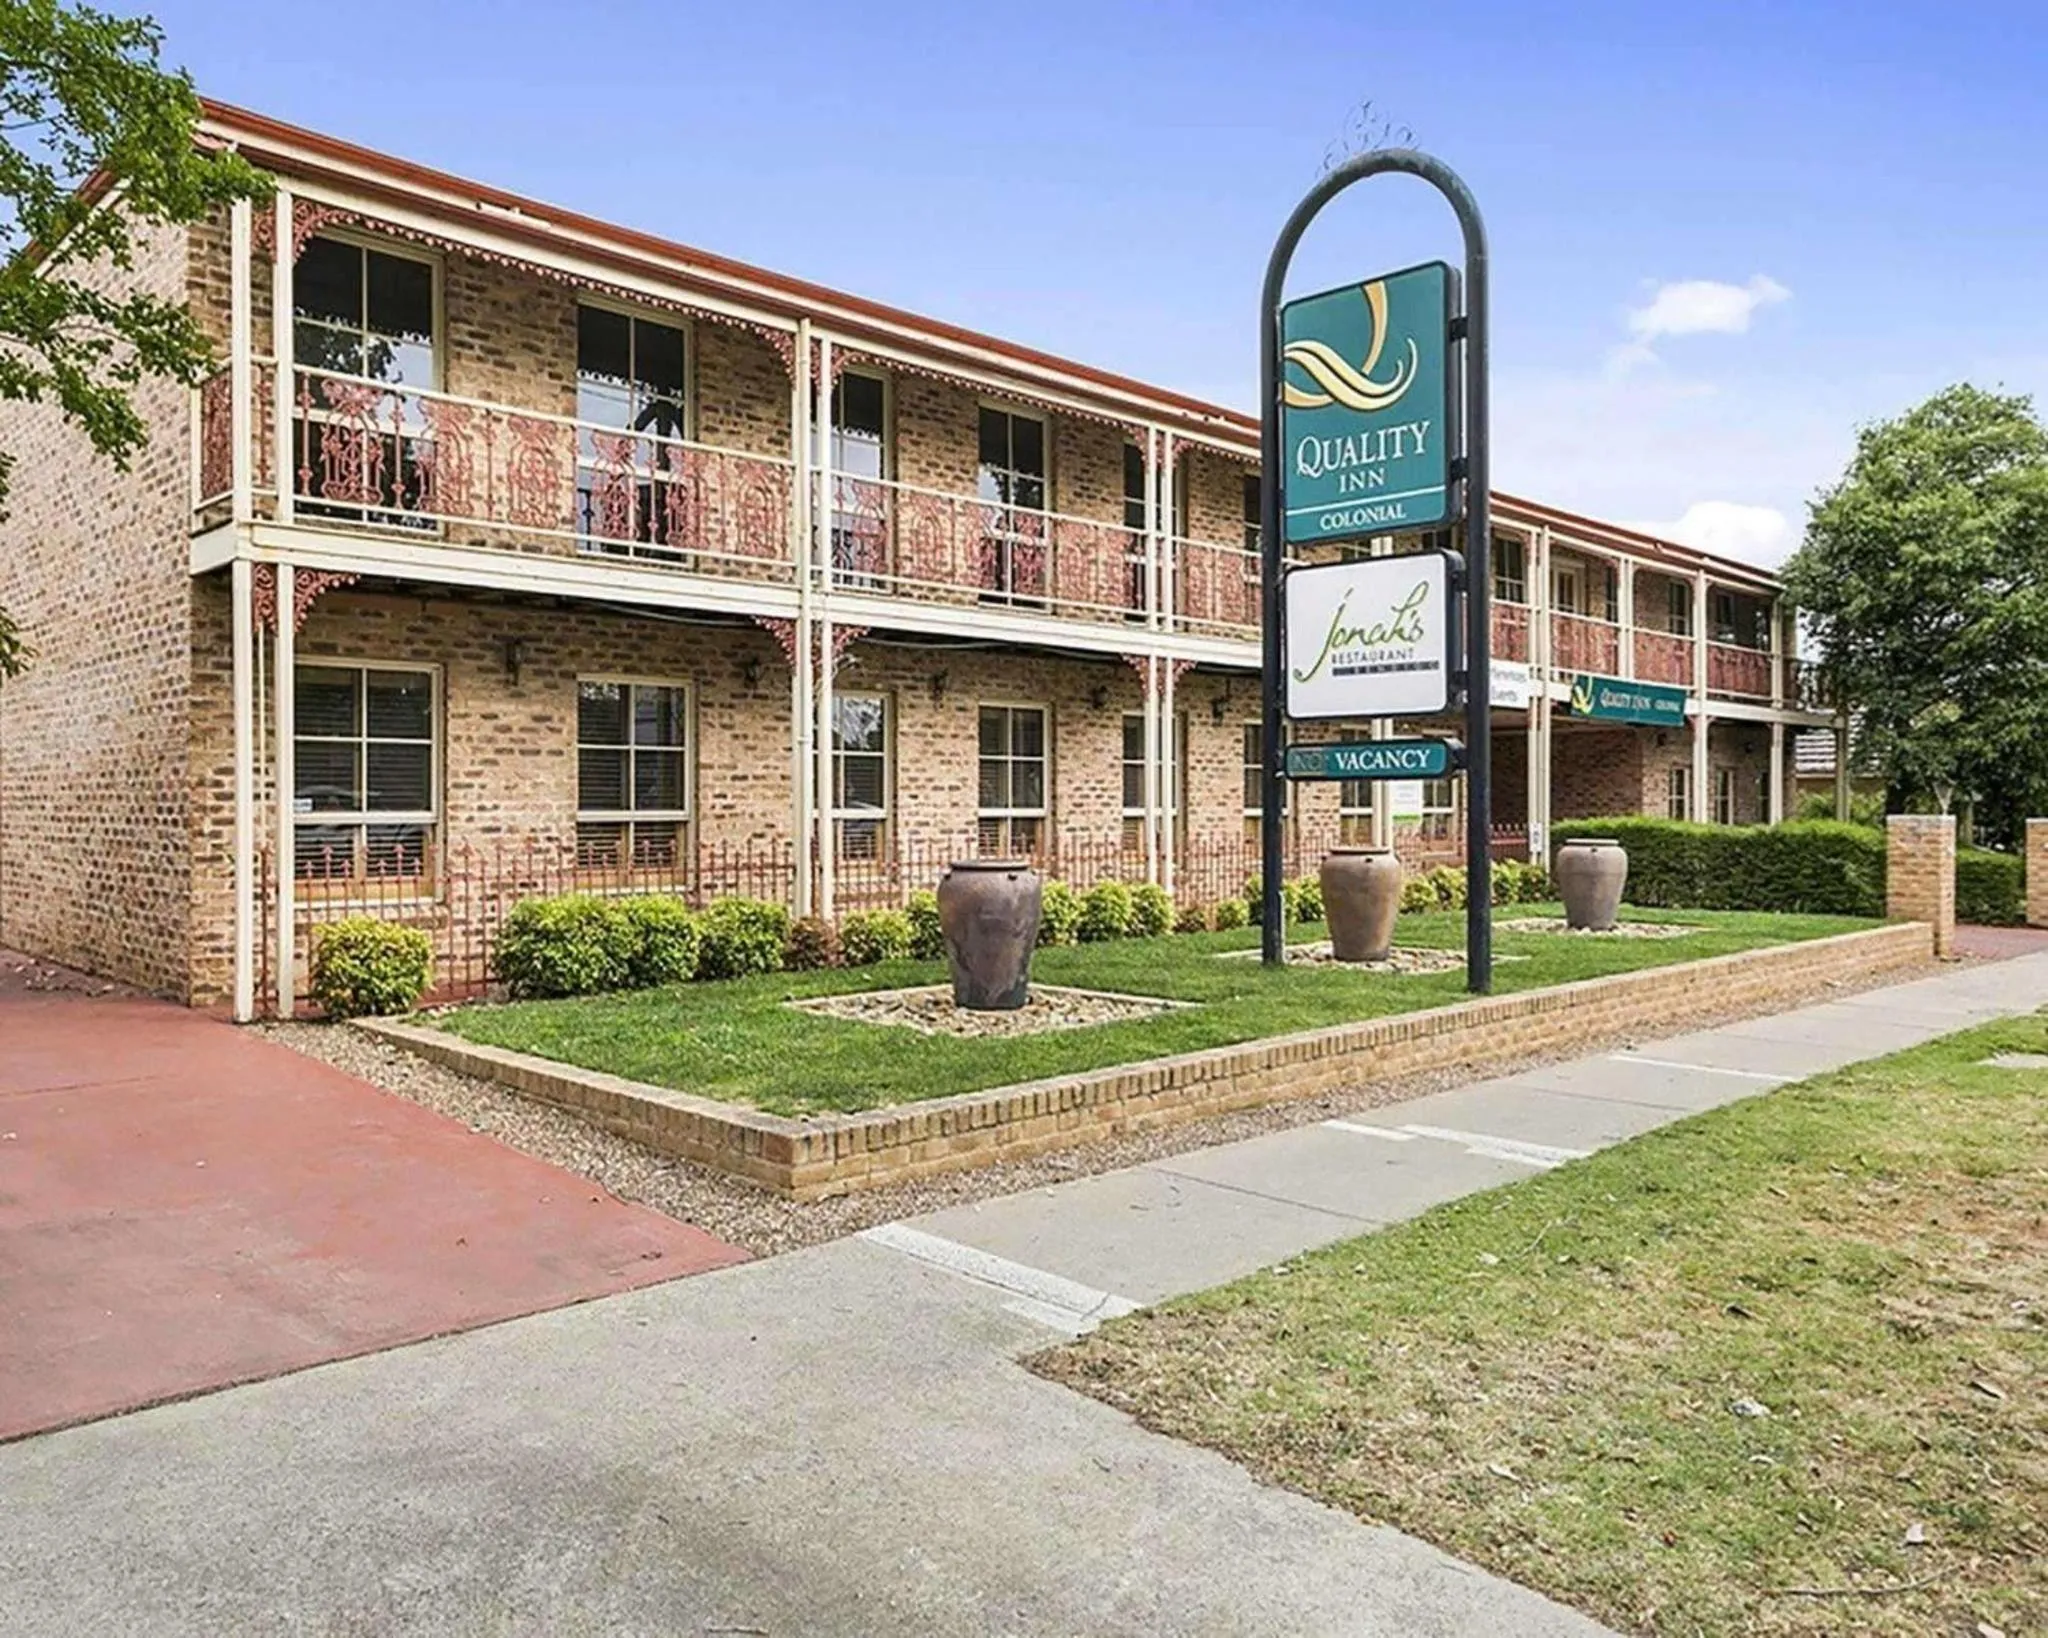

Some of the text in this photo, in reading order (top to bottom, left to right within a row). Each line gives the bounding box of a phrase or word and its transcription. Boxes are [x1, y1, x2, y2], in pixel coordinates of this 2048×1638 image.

[1297, 420, 1430, 478] QUALITY
[1339, 468, 1385, 493] INN
[1320, 503, 1407, 531] COLONIAL
[1332, 648, 1414, 665] RESTAURANT
[1335, 748, 1431, 771] VACANCY
